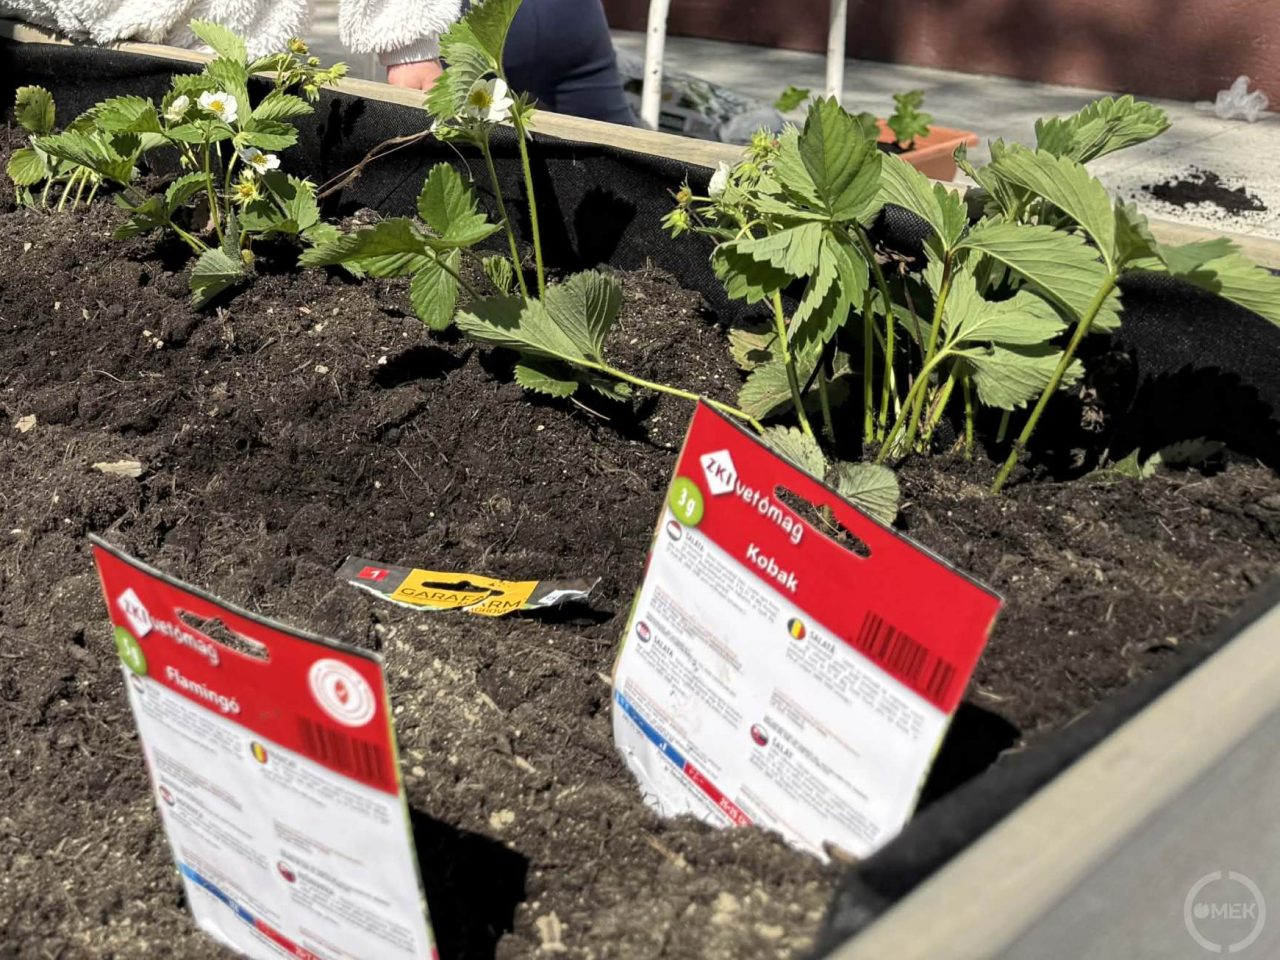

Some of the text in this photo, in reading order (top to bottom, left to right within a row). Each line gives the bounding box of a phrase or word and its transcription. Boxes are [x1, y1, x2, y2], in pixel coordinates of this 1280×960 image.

[705, 457, 804, 544] ZKI vetómag
[746, 542, 799, 592] Kobak
[165, 665, 241, 714] Flamingó
